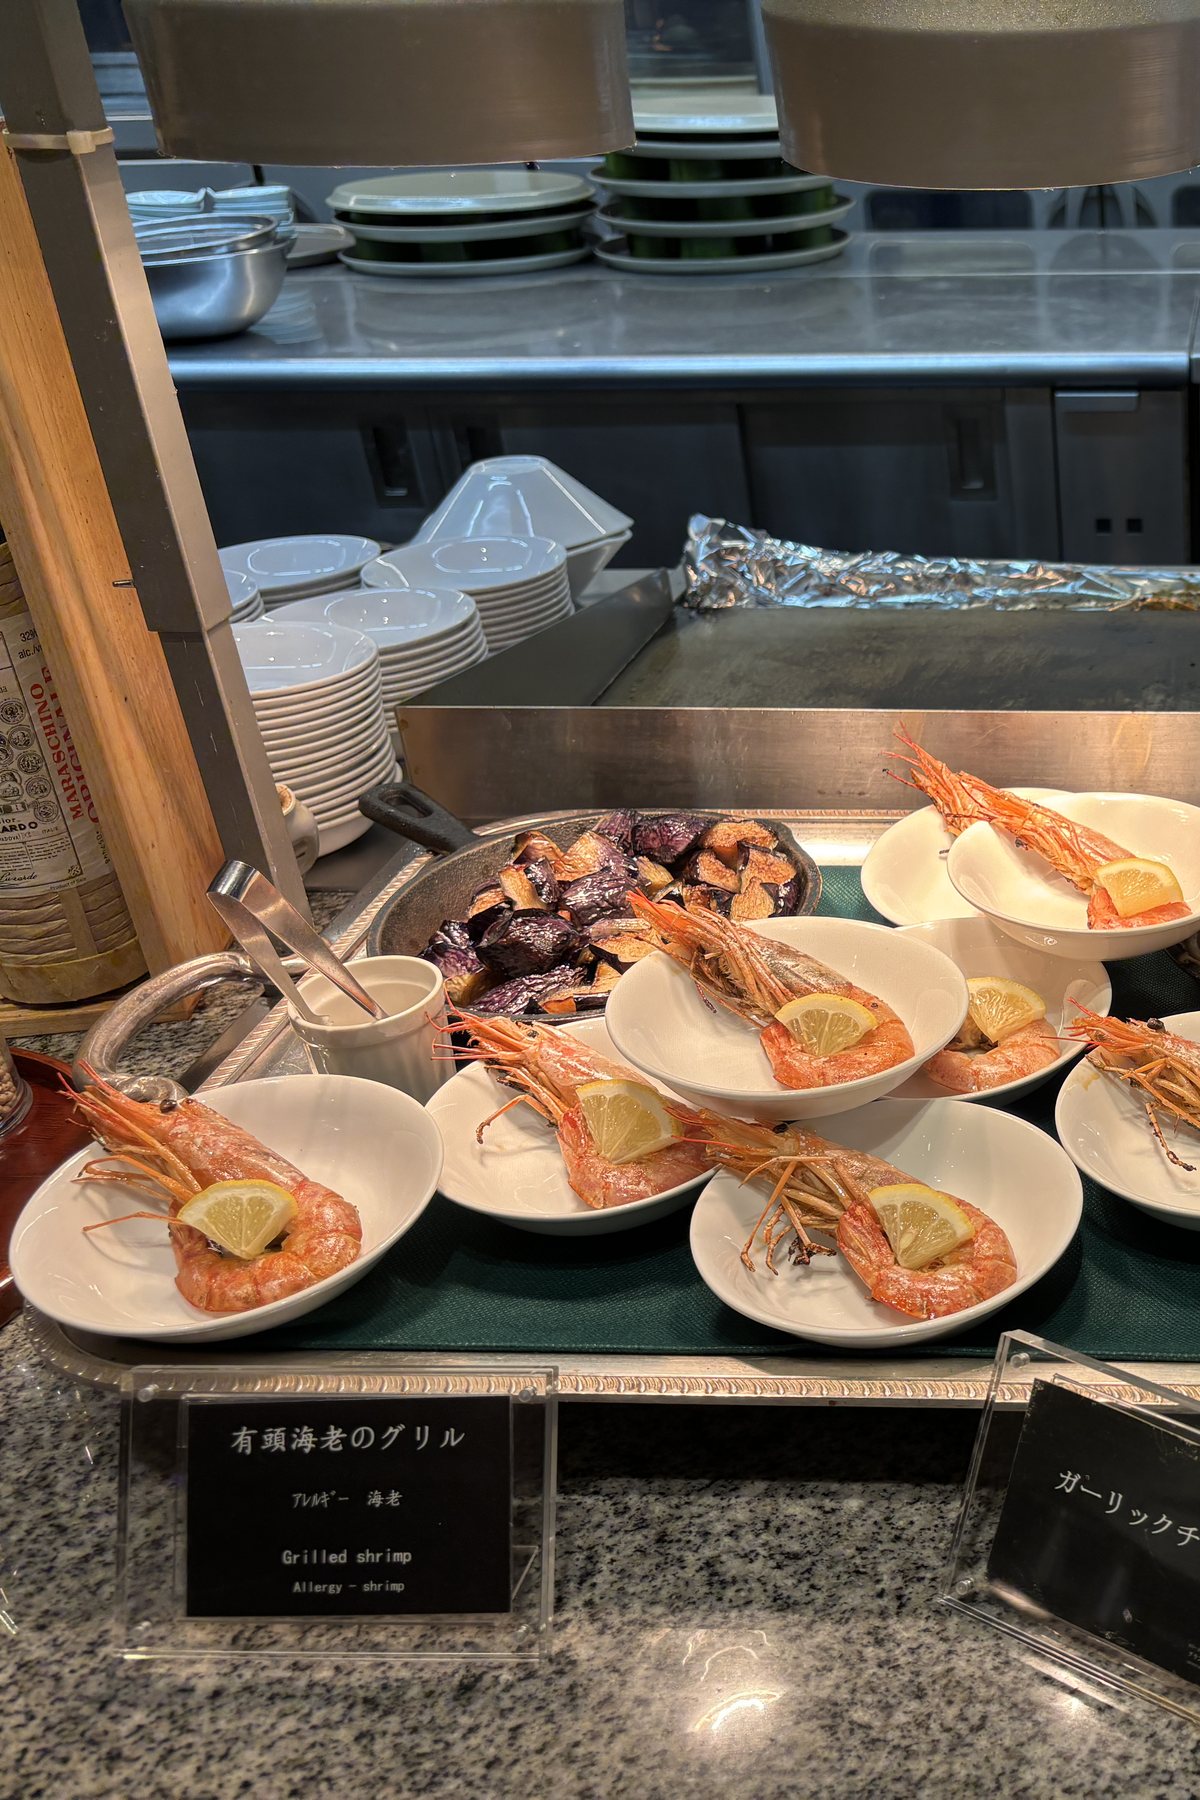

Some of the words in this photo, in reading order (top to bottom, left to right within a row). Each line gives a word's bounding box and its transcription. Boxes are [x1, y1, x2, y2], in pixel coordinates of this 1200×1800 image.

[30, 683, 84, 820] MARASCHINO
[230, 1423, 465, 1455] 有頭海老のグリル
[367, 1490, 403, 1508] 海老
[282, 1549, 347, 1565] Grilled
[356, 1549, 412, 1566] shrimp
[293, 1581, 343, 1595] Allergy
[363, 1581, 405, 1593] shrimp
